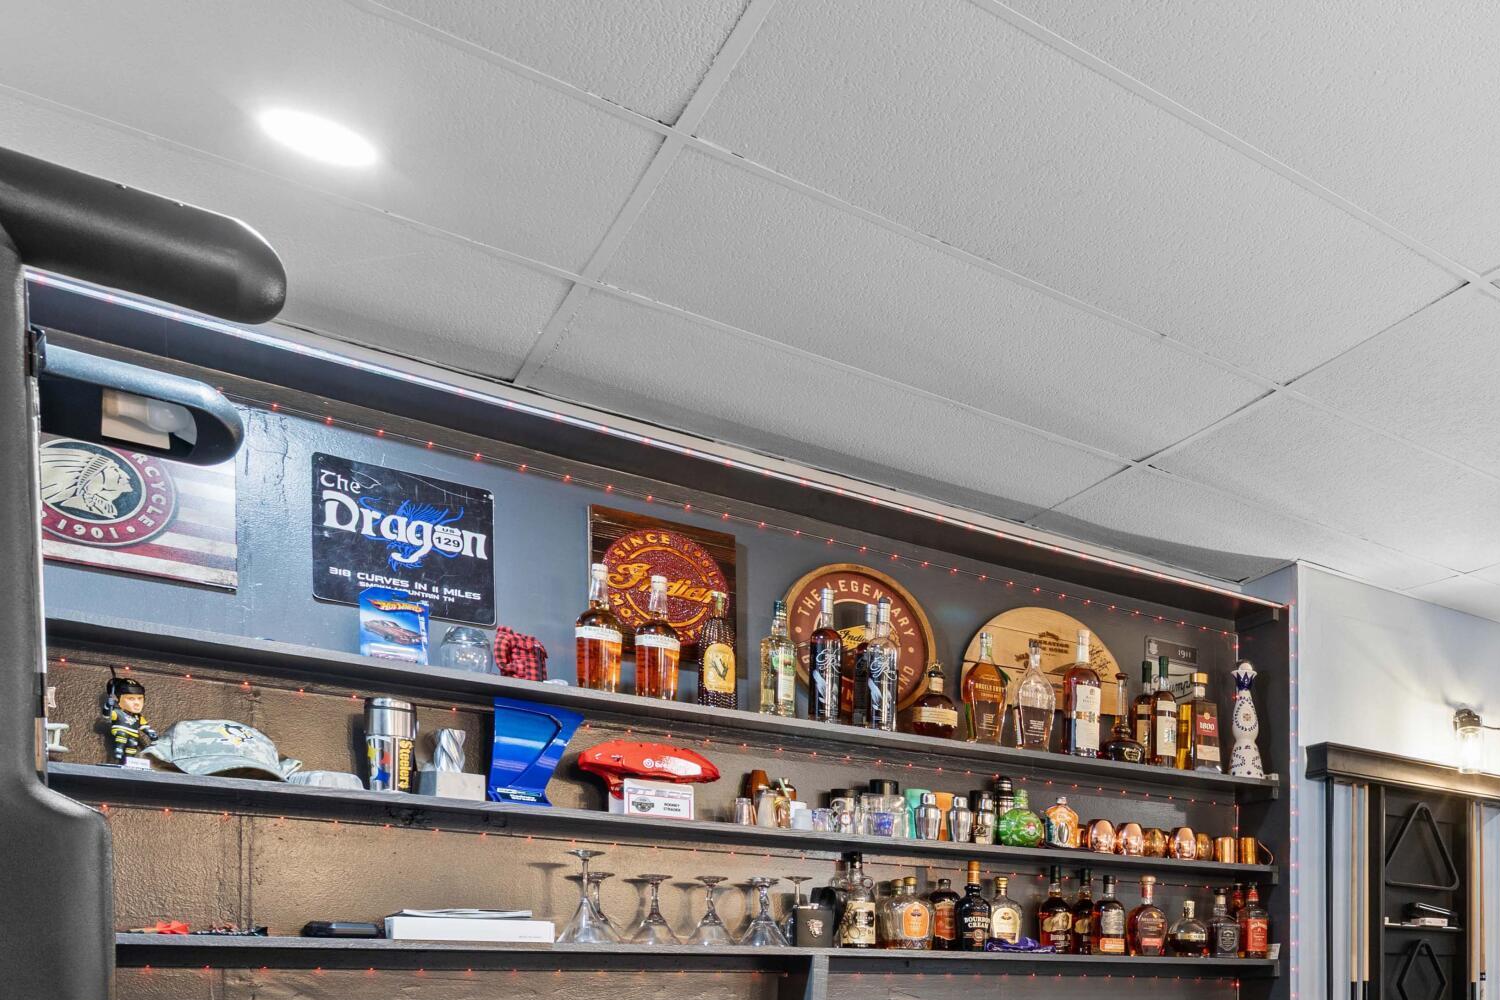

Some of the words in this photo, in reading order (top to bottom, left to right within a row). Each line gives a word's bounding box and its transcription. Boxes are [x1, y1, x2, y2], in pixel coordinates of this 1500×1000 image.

[131, 453, 167, 528] RCYCLE
[319, 469, 361, 494] The
[57, 518, 119, 539] 1901
[321, 489, 488, 563] Dragon
[435, 536, 461, 549] 129
[611, 533, 671, 559] SINCE
[328, 566, 352, 577] 318
[356, 572, 410, 588] CURVES
[414, 581, 428, 592] IN
[443, 587, 482, 601] MILES
[797, 588, 822, 616] THE
[1178, 649, 1192, 659] 1911
[1199, 722, 1215, 731] 1800
[399, 739, 414, 789] Steelers
